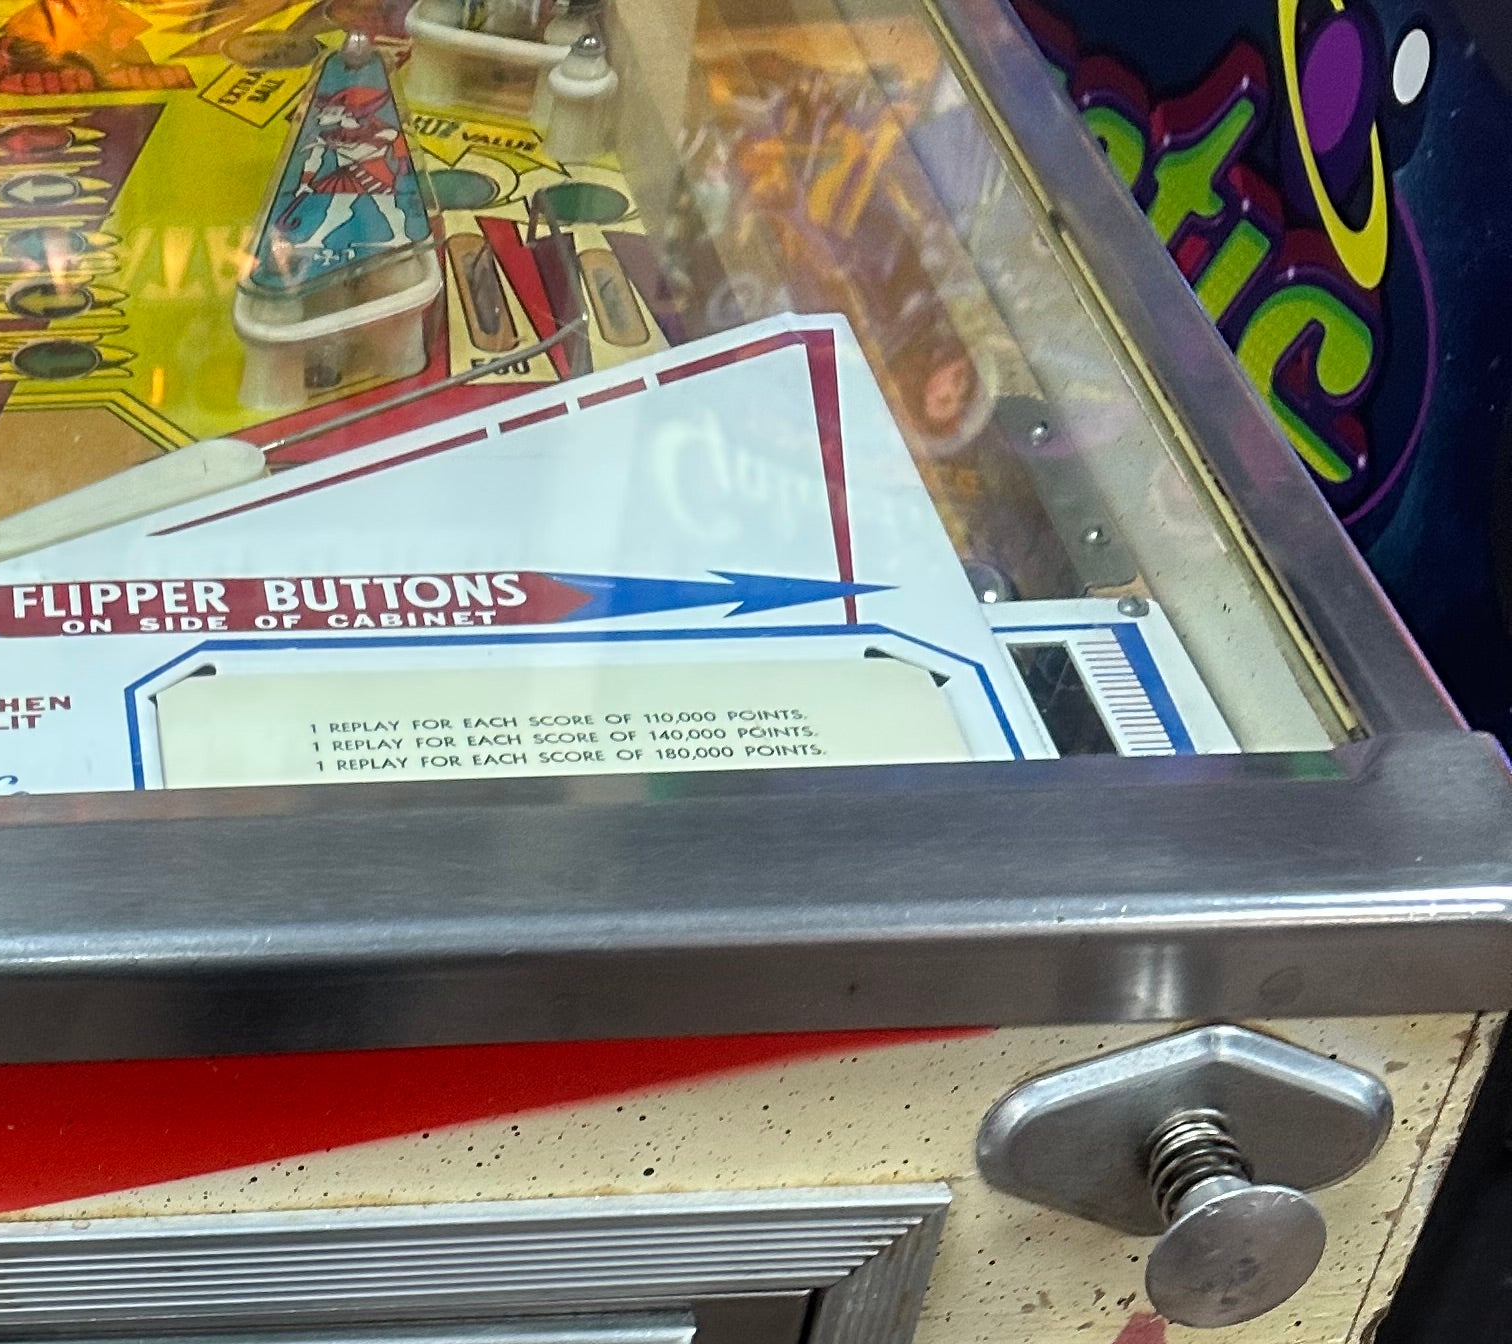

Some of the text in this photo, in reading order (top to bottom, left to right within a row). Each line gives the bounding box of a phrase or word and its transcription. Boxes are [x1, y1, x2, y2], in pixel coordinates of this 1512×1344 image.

[11, 573, 528, 619] FLIPPER BUTTONS
[61, 610, 498, 634] ON SIDE OF CABINET
[309, 722, 317, 734] 1
[329, 719, 400, 734] REPLAY
[412, 718, 454, 731] FOR
[462, 717, 519, 730] EACH
[528, 714, 595, 728] SCORE
[604, 713, 634, 726] OF
[642, 710, 717, 726] 110,000
[312, 741, 320, 752] 1
[332, 738, 404, 752] REPLAY
[415, 736, 457, 749] FOR
[466, 734, 523, 747] EACH
[532, 732, 601, 745] SCORE
[609, 730, 638, 742] OF
[647, 727, 727, 743] 140,000
[315, 744, 827, 772] 1 REPLAY FOR EACH SCORE OF 180,000 POINTS.
